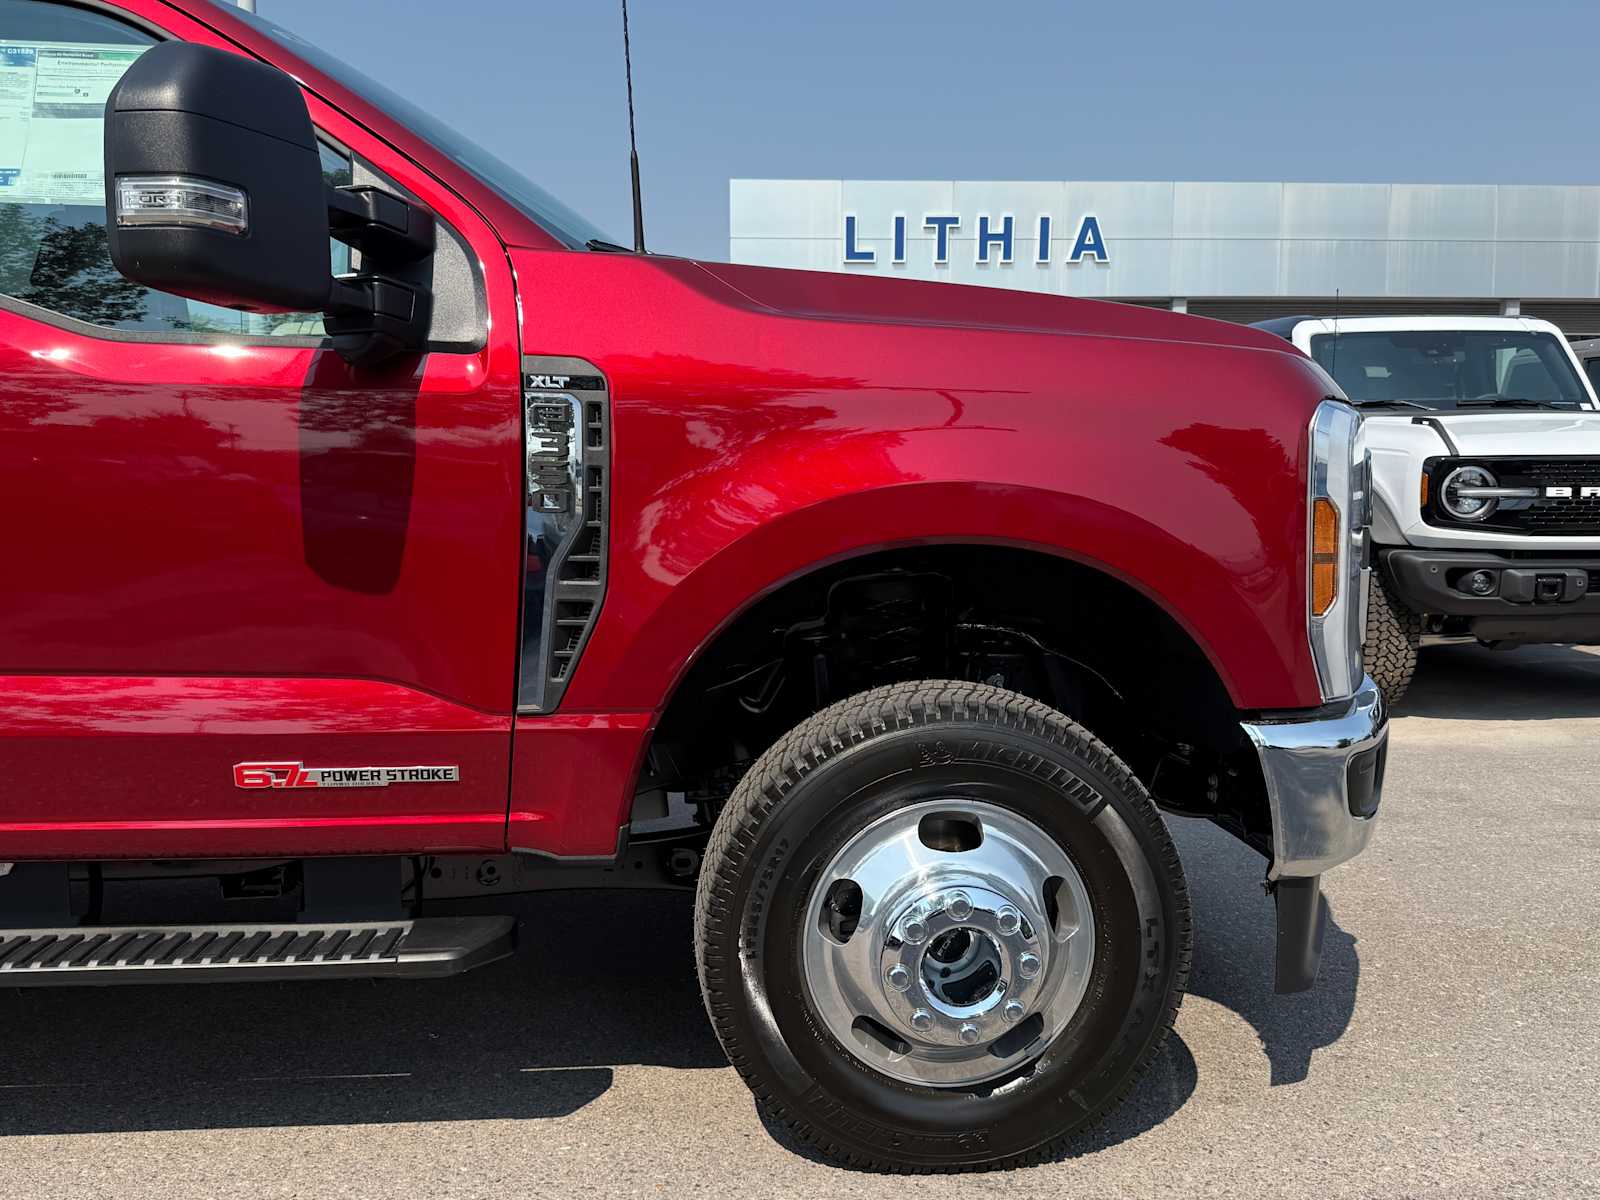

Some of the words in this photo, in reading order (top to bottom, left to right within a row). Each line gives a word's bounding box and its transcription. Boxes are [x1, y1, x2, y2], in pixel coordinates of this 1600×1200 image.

[844, 214, 1110, 264] LITHIA
[529, 375, 570, 389] XLT
[321, 770, 381, 782] POWER
[386, 767, 454, 781] STROKE
[955, 741, 1101, 810] MICHELIN
